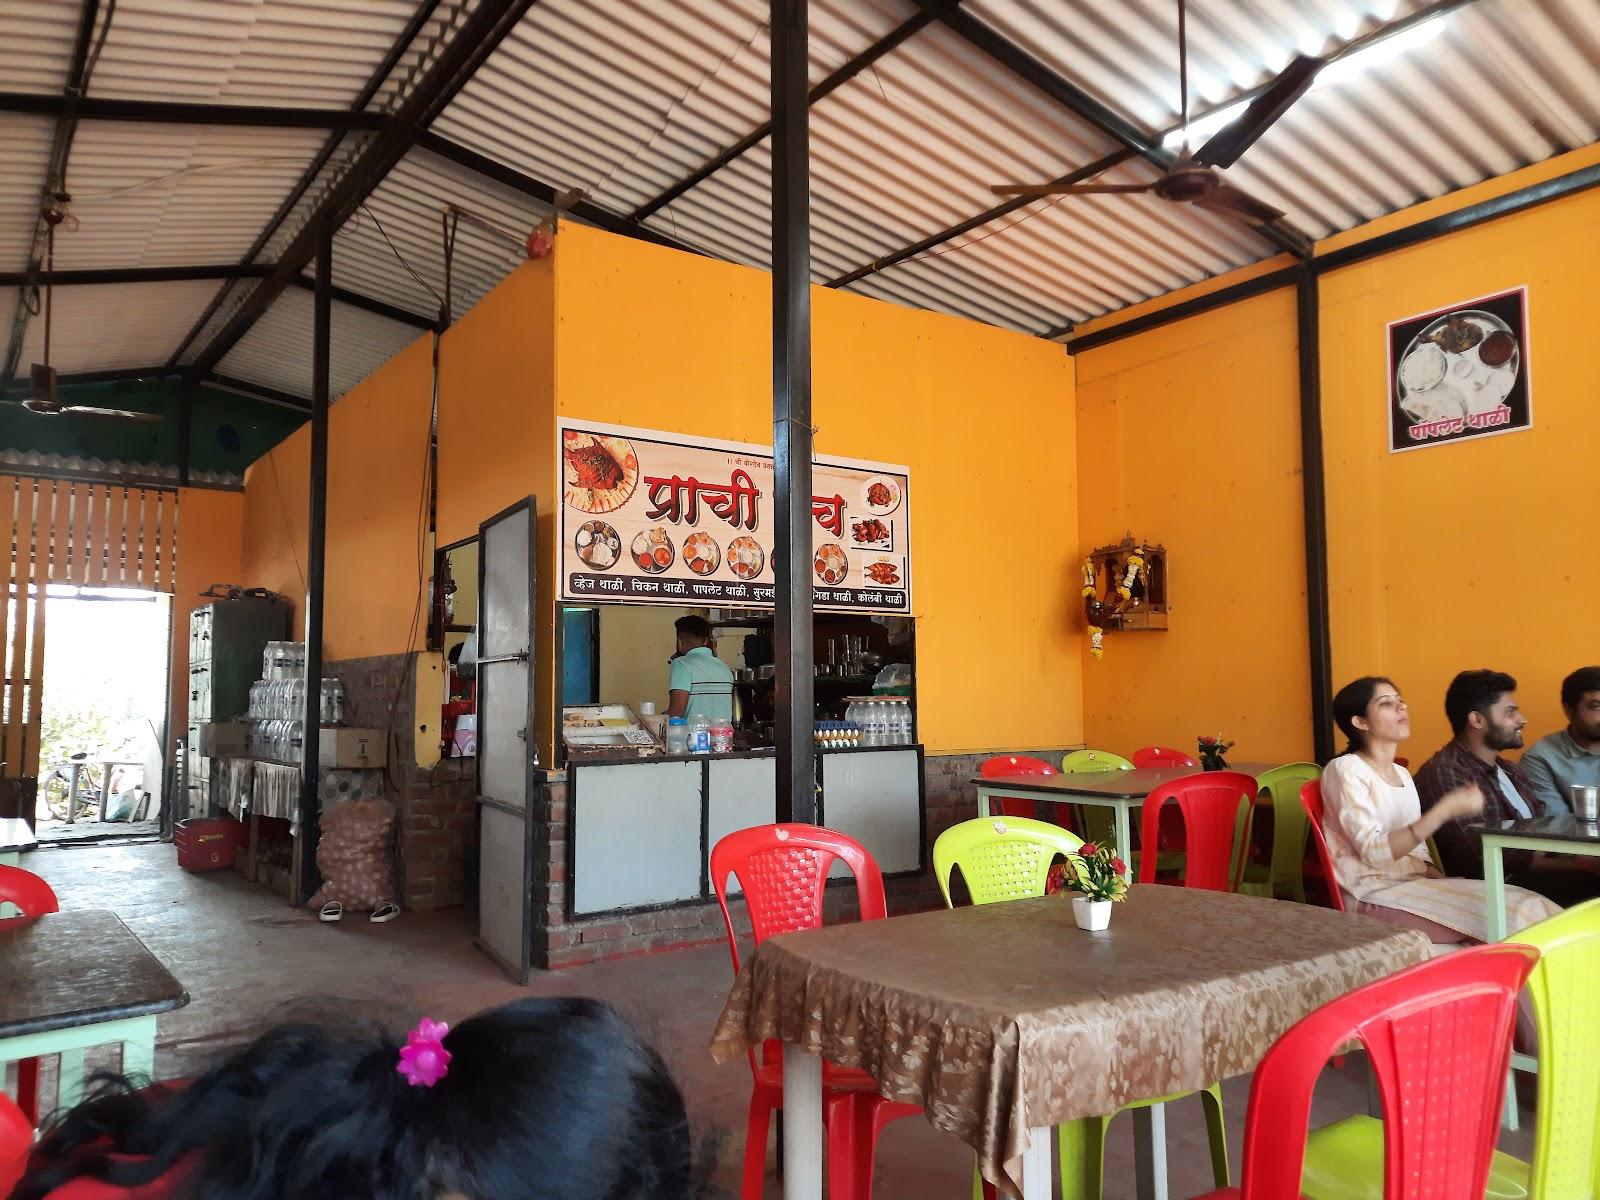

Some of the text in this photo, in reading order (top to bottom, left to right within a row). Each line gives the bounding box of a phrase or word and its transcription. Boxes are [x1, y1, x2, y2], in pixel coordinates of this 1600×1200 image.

[1468, 404, 1512, 428] थाळी
[644, 468, 846, 538] प्राची च
[574, 575, 595, 589] व्हेज
[631, 578, 659, 593] चिकन
[692, 582, 722, 596] पापलेट
[857, 590, 882, 604] कोलंबी
[885, 593, 903, 605] थाळी
